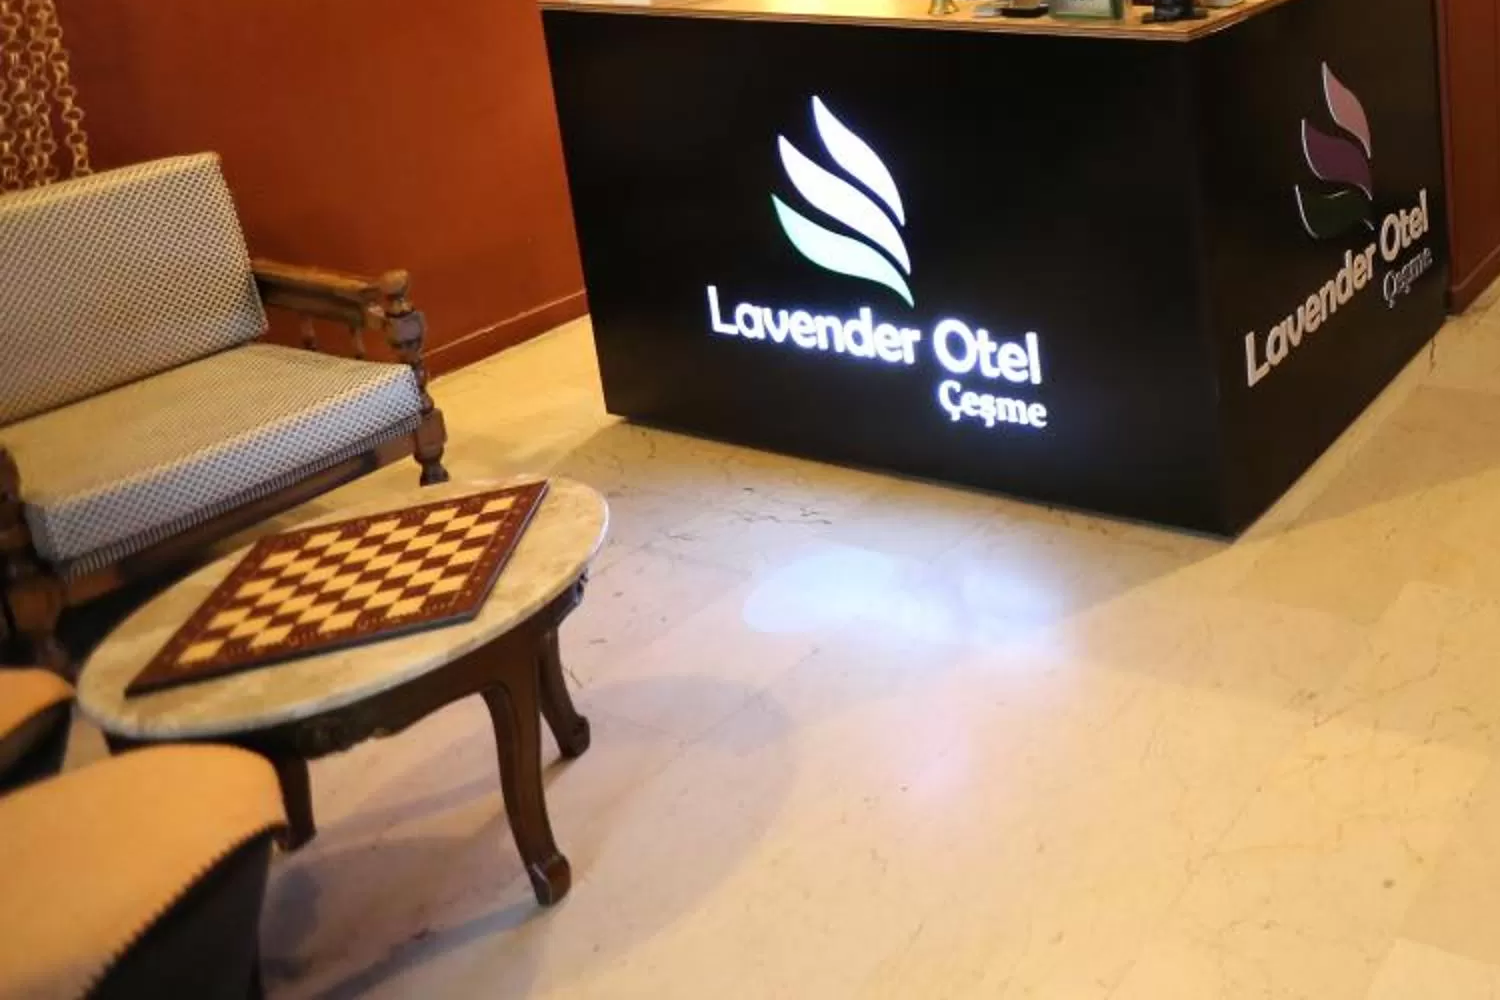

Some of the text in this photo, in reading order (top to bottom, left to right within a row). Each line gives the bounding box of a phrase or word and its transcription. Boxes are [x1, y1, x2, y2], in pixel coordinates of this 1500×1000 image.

[707, 285, 1042, 385] Lavender Otel
[1245, 187, 1429, 388] Lavender Otel
[938, 379, 1048, 428] Çeşme
